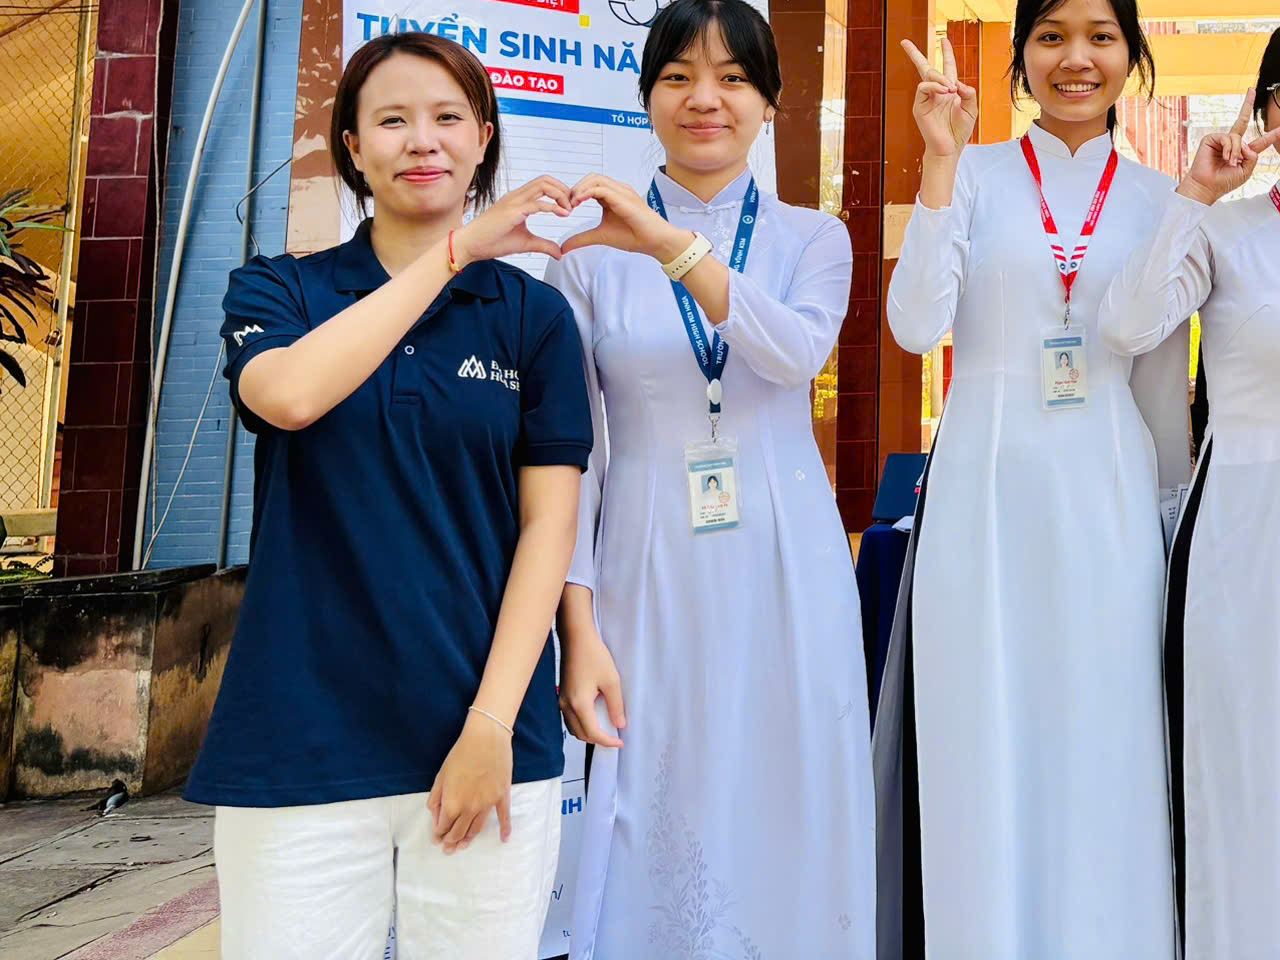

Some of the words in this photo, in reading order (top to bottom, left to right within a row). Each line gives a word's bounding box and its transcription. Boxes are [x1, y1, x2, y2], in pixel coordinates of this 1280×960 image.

[499, 30, 582, 66] SINH
[593, 40, 641, 74] NĂ
[490, 71, 524, 86] ĐÀO
[528, 76, 558, 93] TẠO
[627, 116, 648, 127] HỢP
[691, 322, 700, 339] HIGH
[696, 339, 709, 366] SCHOOL
